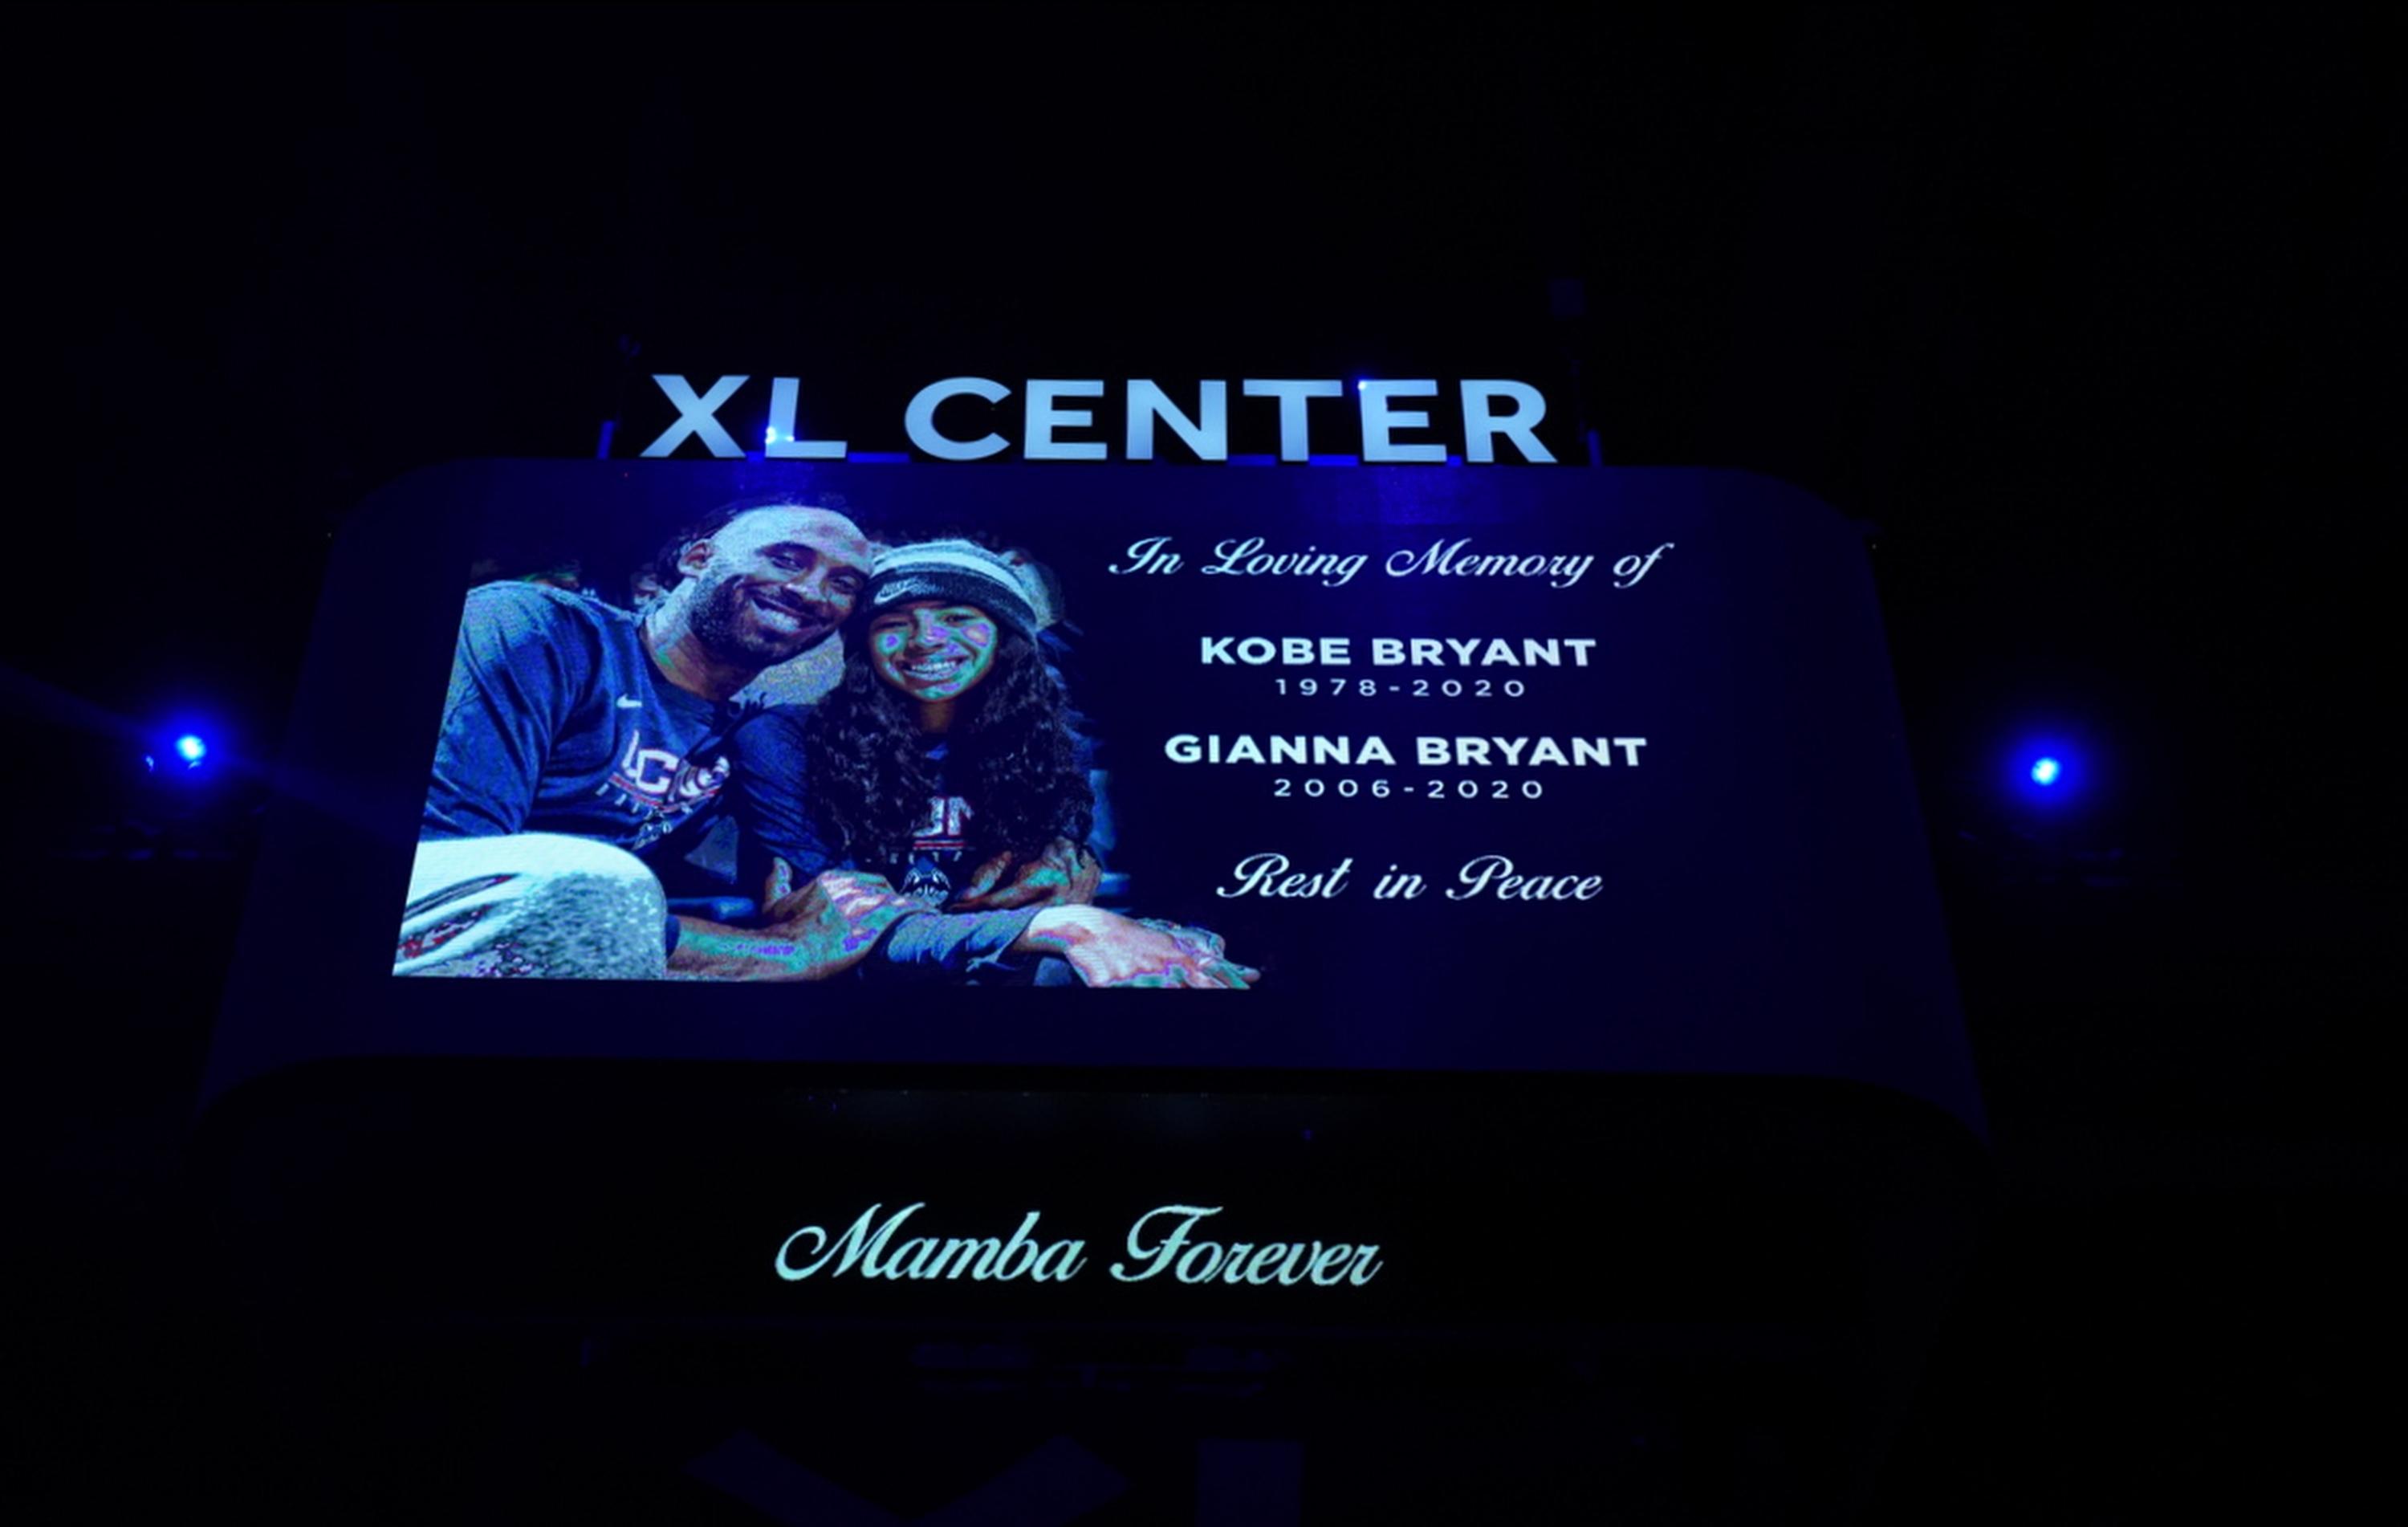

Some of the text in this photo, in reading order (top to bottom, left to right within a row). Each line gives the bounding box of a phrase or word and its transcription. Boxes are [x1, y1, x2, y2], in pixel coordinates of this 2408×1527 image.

[641, 375, 1556, 462] XL CENTER
[1108, 536, 1675, 588] In Loving Memory of
[1201, 637, 1597, 667] KOBE BRYANT
[1275, 678, 1525, 698] 1978-2020
[1164, 734, 1647, 767] GIANNA BRYANT
[1274, 778, 1543, 800] 2006-2020
[1215, 853, 1603, 901] Rest in Peace
[775, 1202, 1384, 1286] Mamba Forever
